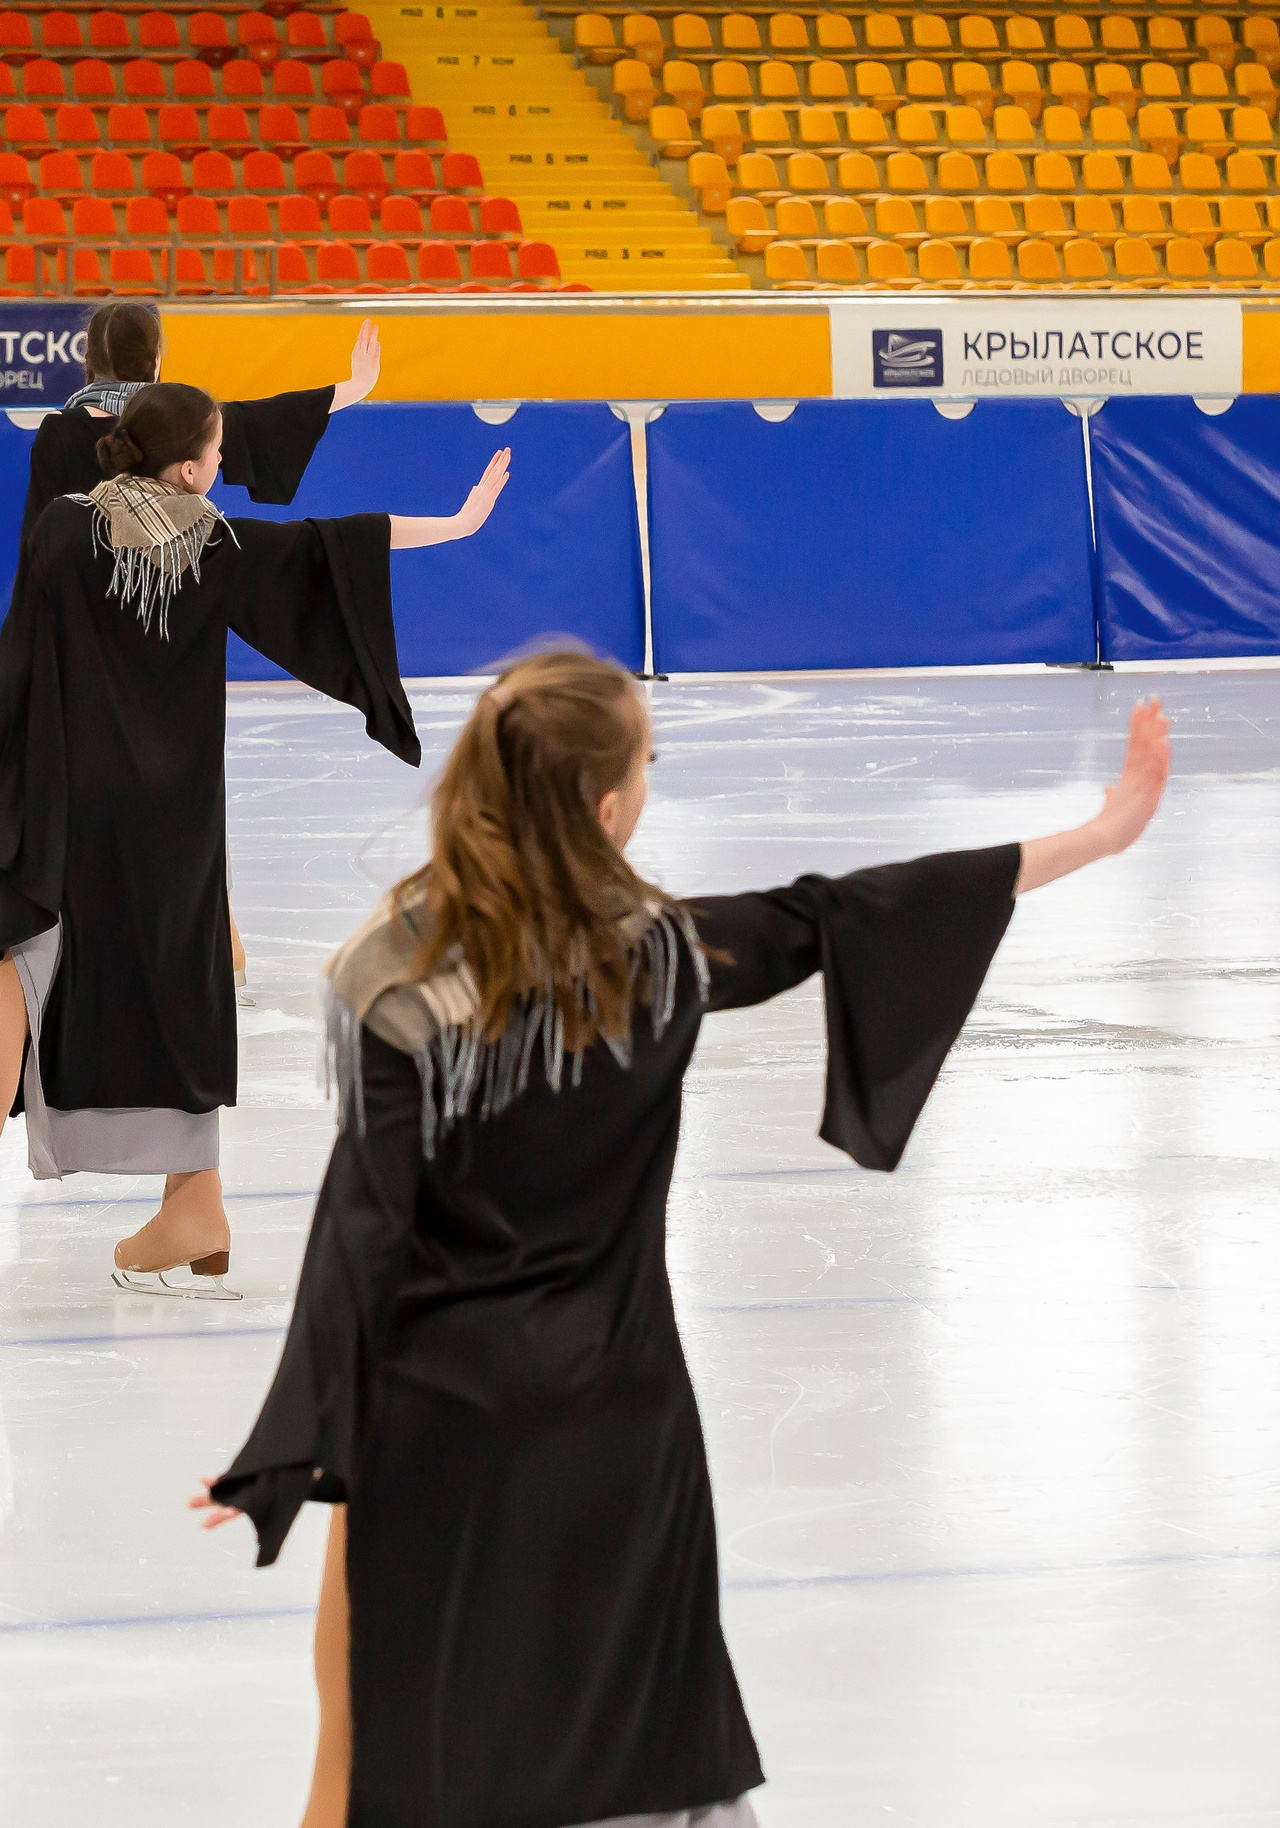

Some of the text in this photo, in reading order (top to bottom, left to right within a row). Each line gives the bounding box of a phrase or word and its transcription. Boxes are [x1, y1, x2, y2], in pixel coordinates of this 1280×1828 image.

[473, 55, 480, 66] 7
[583, 200, 591, 210] 4
[964, 331, 1203, 360] КРЫЛАТСКОЕ
[961, 365, 1132, 387] ЛЕДОВЫЙ ДВОРЕЦ
